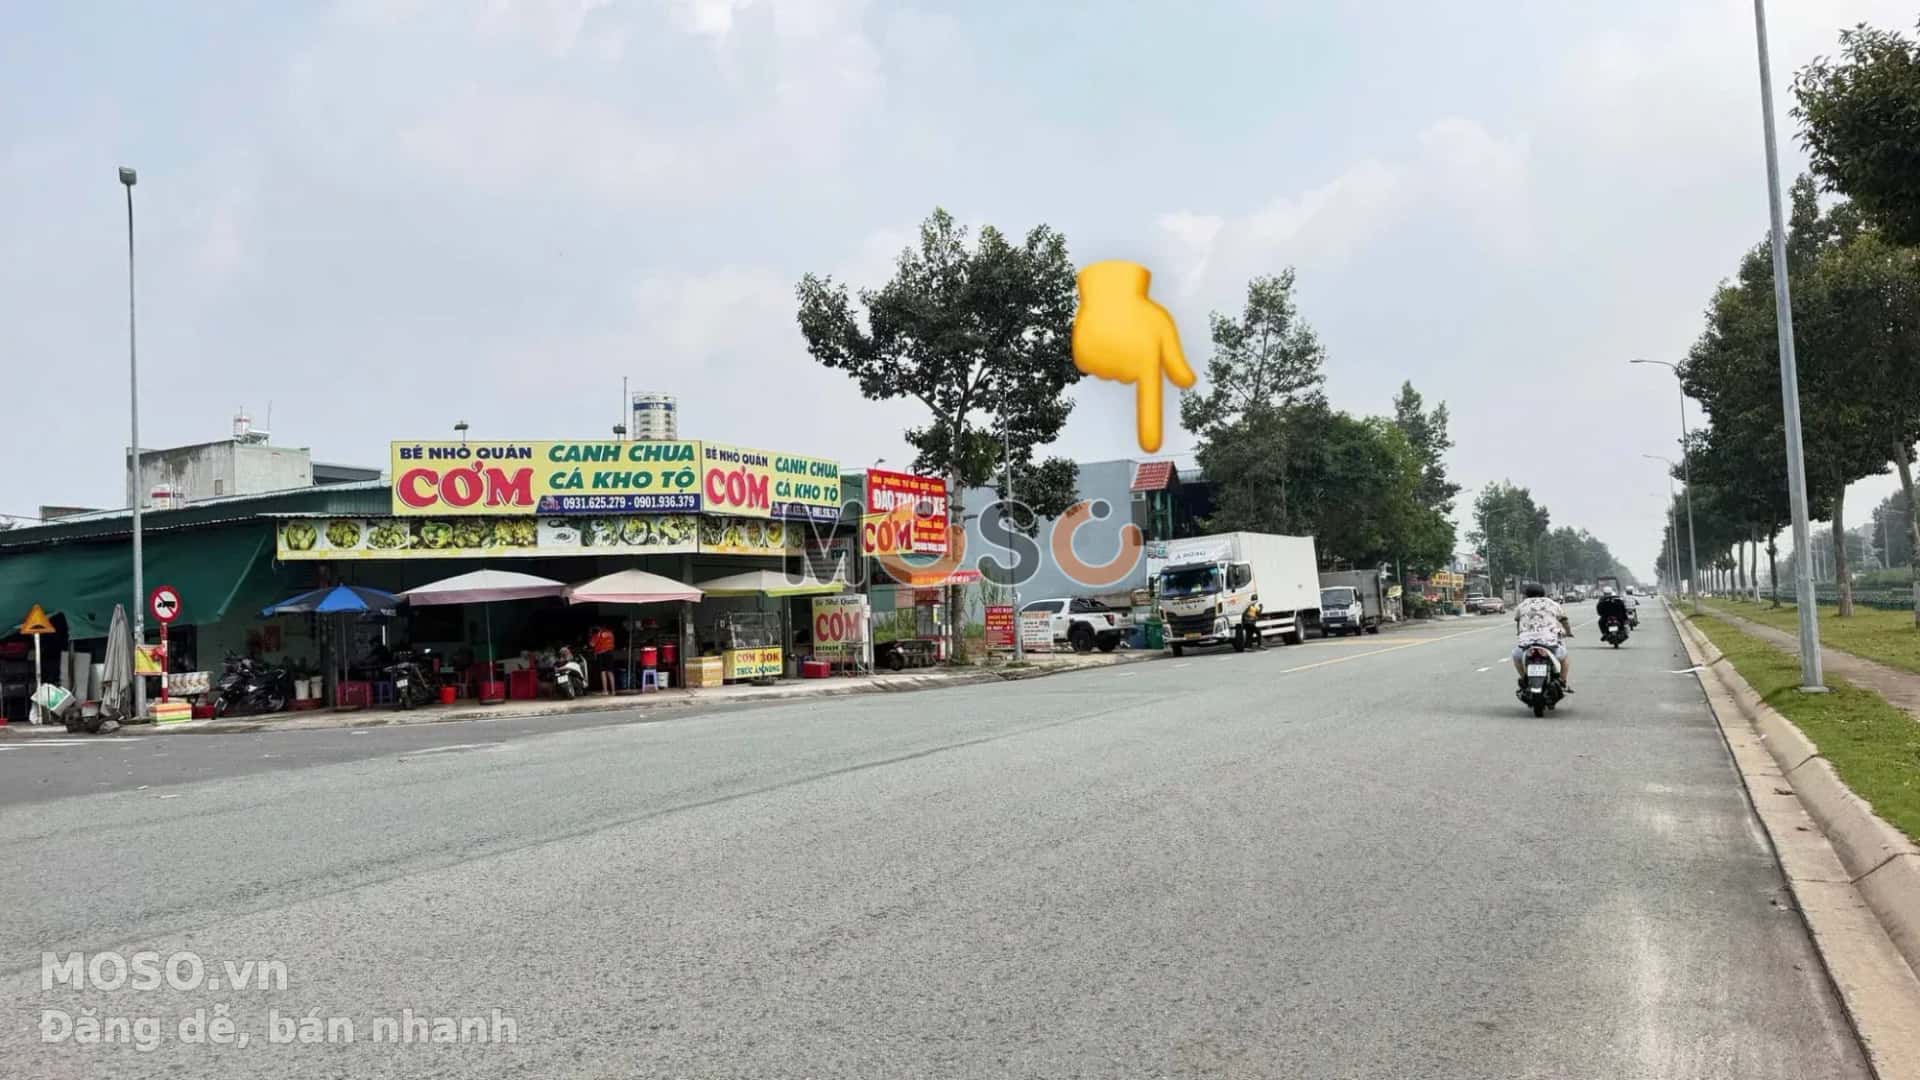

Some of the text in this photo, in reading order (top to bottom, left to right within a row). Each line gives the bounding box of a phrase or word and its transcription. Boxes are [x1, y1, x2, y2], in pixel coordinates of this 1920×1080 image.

[400, 443, 532, 460] BÉ NHỎ QUÁN
[548, 444, 695, 463] CANH CHUA
[705, 446, 769, 467] BÉ NHỎ QUÁN
[549, 466, 695, 493] CÁ KHO TỘ
[775, 456, 838, 479] CANH CHUA
[396, 460, 535, 509] CƠM
[705, 465, 770, 510] CƠM
[775, 479, 839, 506] CÁ KHO TỘ
[563, 496, 626, 510] 0931.625.279
[863, 515, 912, 553] CƠM
[815, 607, 863, 642] CƠM
